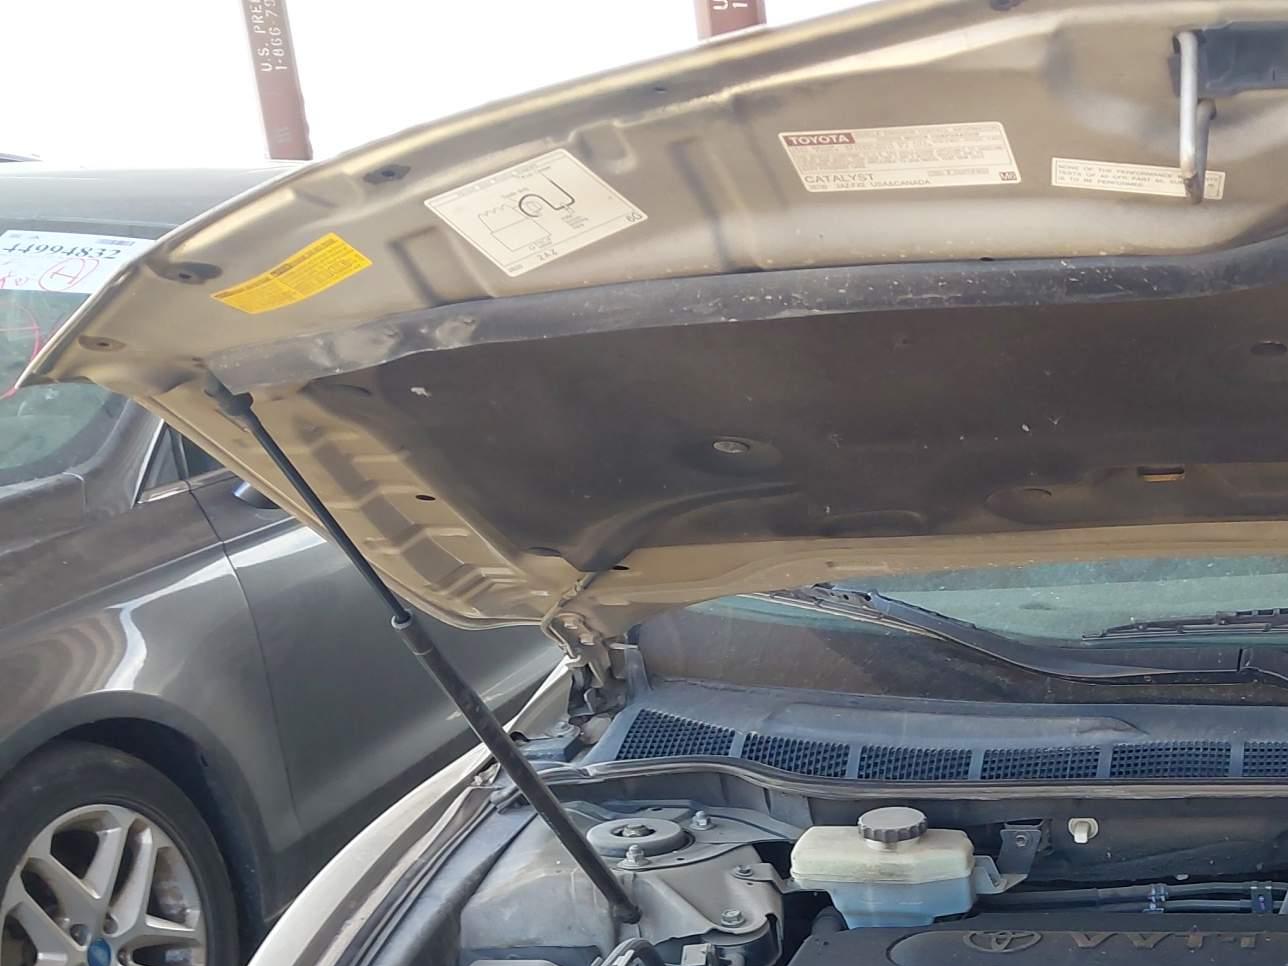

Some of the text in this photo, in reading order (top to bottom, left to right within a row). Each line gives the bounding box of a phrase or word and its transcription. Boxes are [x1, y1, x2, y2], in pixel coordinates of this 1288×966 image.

[787, 134, 851, 146] TOYOTA
[803, 172, 875, 185] CATALYST
[3, 242, 121, 260] 44994832
